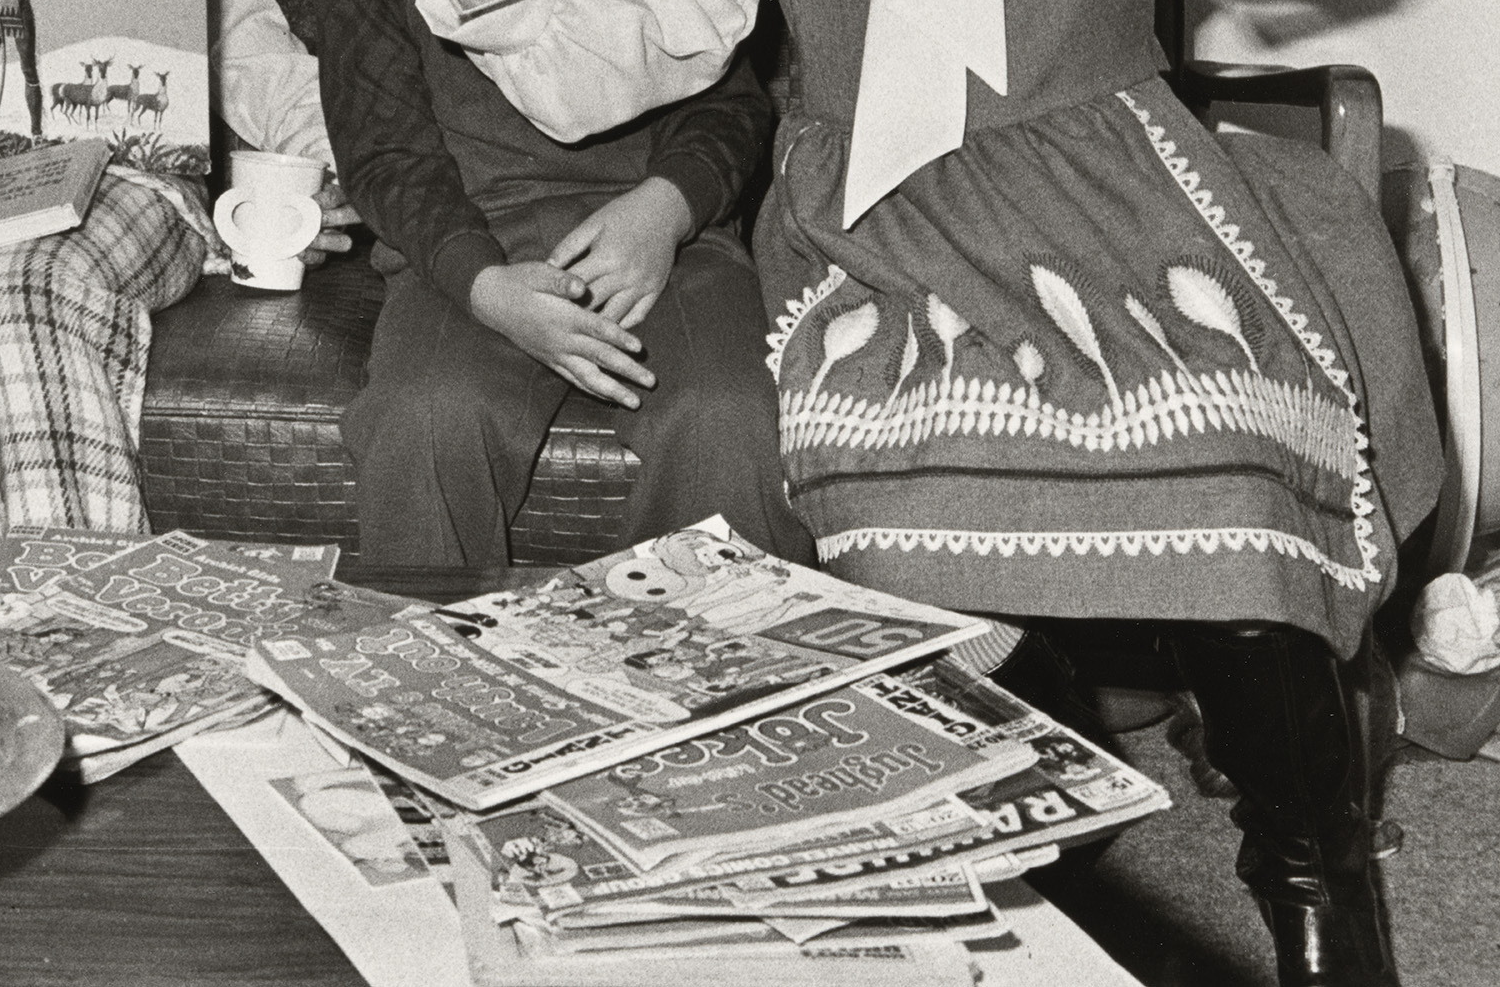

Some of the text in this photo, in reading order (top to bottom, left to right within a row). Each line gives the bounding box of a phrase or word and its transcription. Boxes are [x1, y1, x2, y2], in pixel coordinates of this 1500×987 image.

[871, 680, 977, 737] GIANT
[801, 836, 898, 862] MARVEL
[688, 854, 791, 879] COMICS
